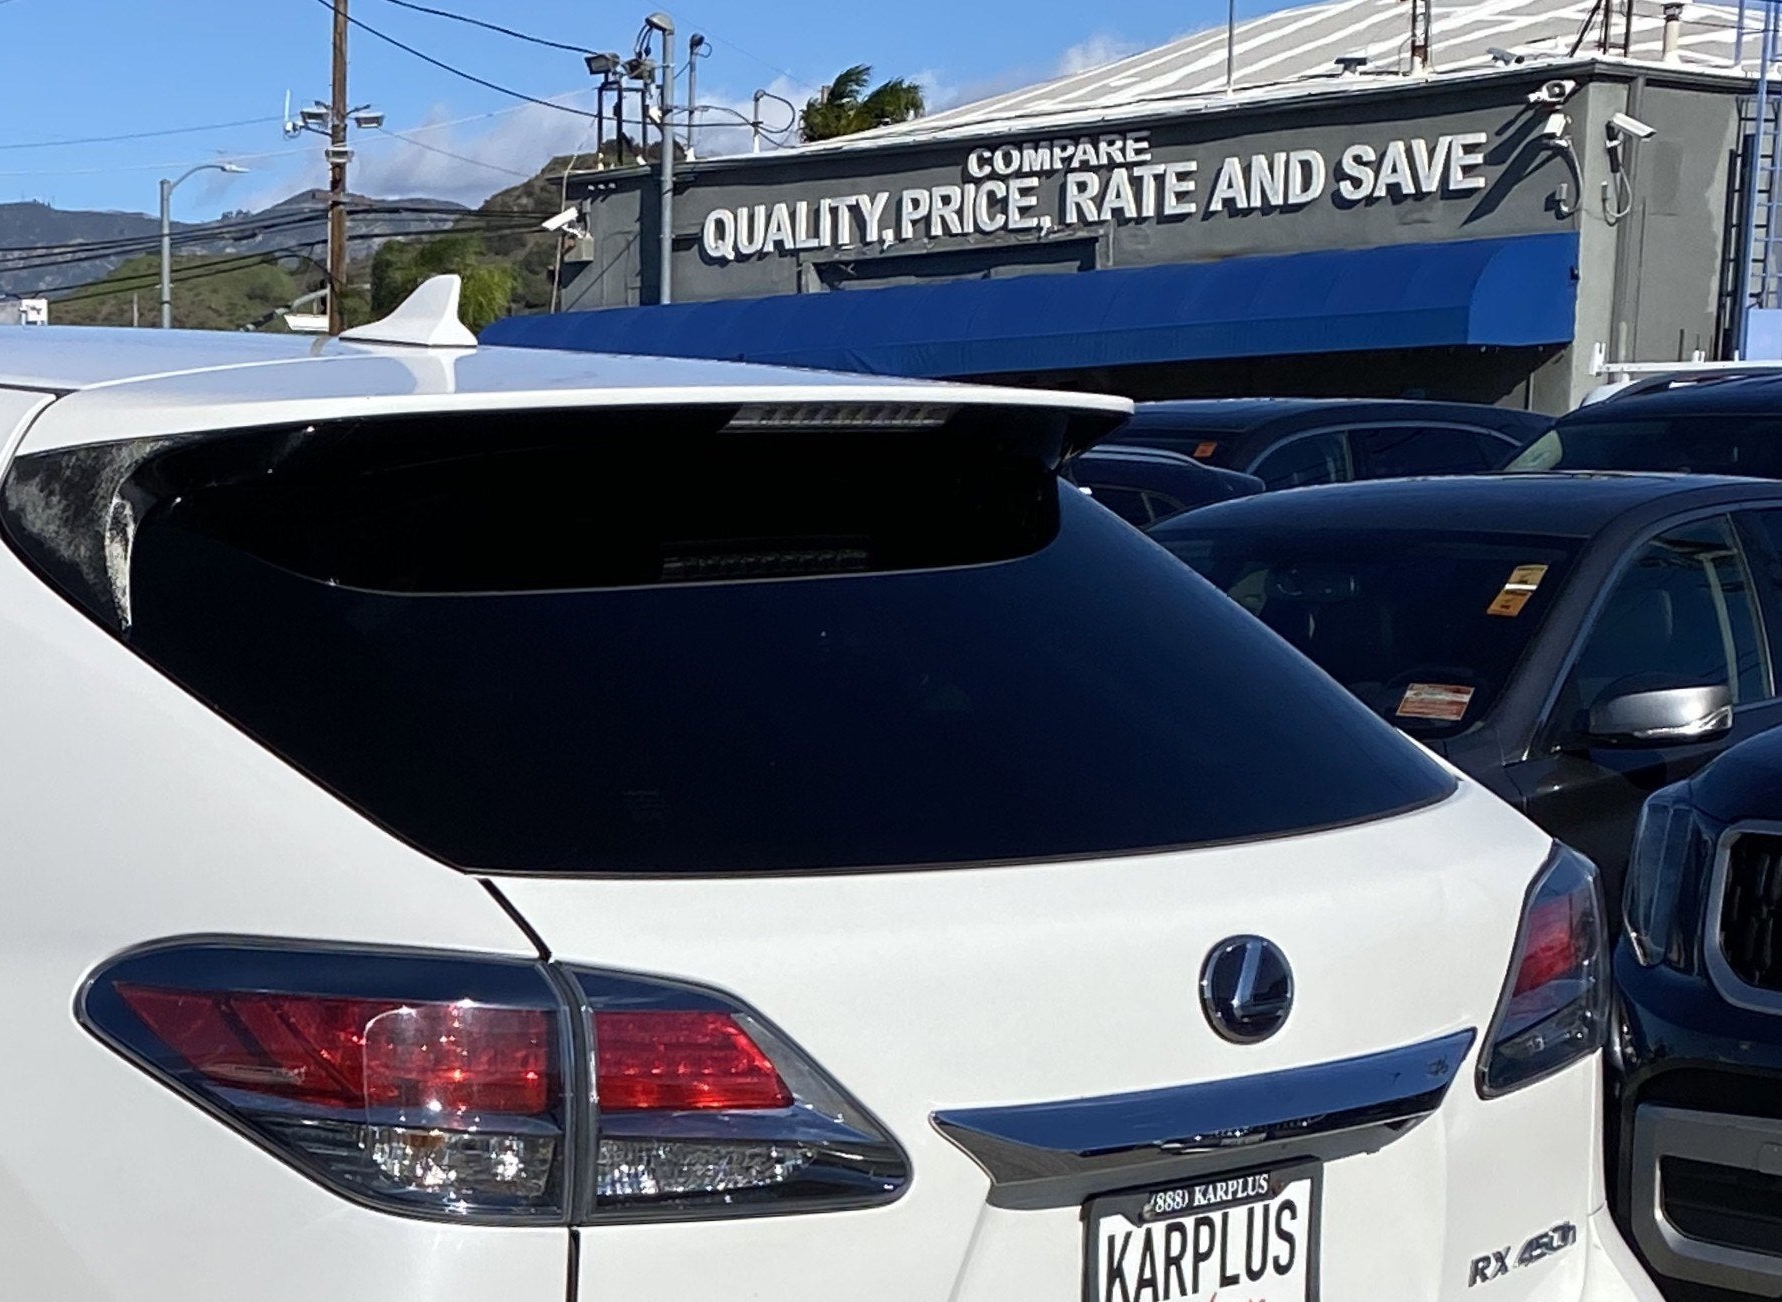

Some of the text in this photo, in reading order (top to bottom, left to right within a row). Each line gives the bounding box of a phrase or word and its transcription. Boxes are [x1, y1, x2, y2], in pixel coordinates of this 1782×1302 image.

[967, 131, 1151, 177] COMPARE
[702, 132, 1487, 260] QUALITY, PRICE, RATE AND SAVE
[1150, 1173, 1269, 1213] (888) KARPLUS
[1468, 1245, 1511, 1288] RX
